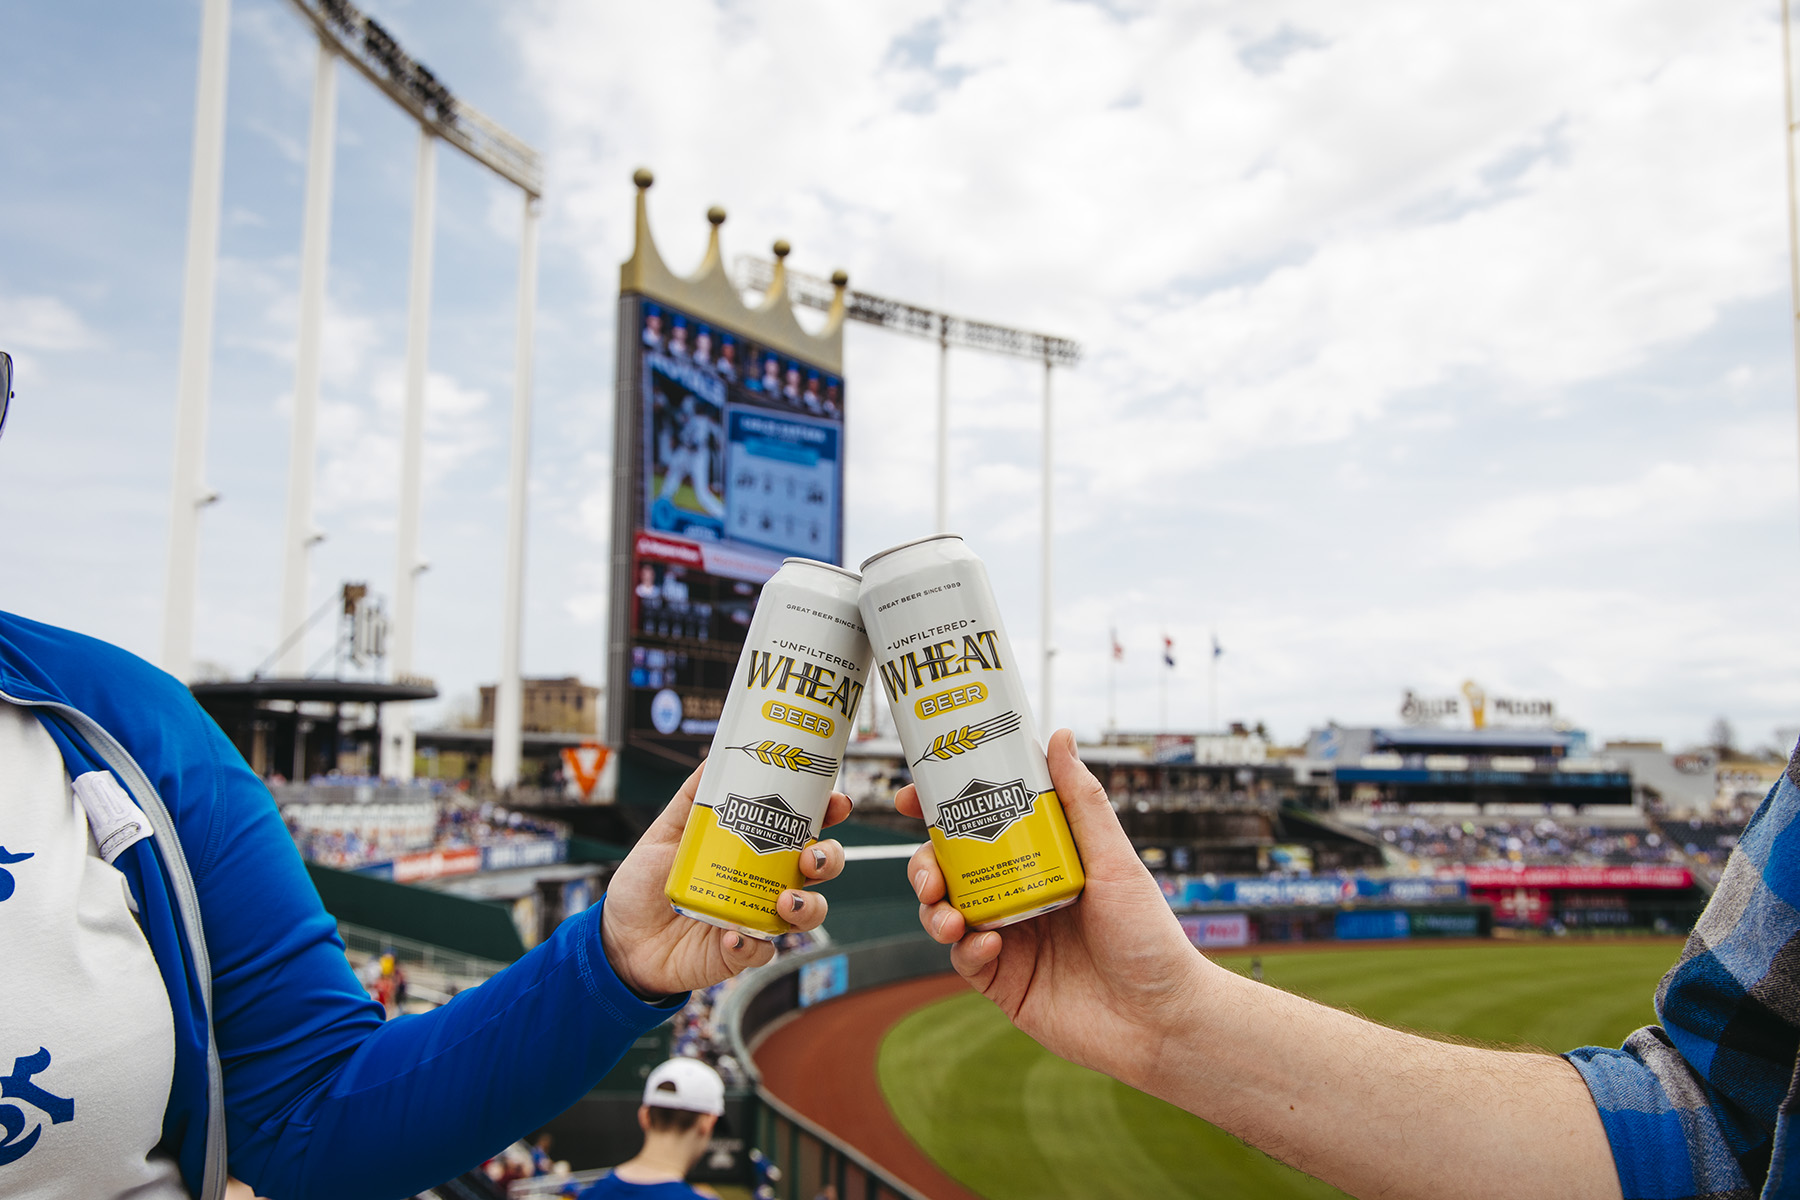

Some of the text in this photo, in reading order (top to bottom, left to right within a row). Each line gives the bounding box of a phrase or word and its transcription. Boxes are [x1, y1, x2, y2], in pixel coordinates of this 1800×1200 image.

[878, 581, 961, 613] GREAT BEER SINCE 1989
[786, 603, 811, 614] GREAT
[812, 610, 834, 621] BEER
[834, 617, 857, 630] SINCE
[892, 619, 968, 650] UNFILTERED
[779, 640, 855, 671] UNFILTERED
[880, 629, 1004, 704] WHEAT
[747, 650, 865, 723] WHEAT
[920, 685, 984, 717] BEER
[769, 702, 832, 736] BEER
[725, 799, 808, 845] BOULEVARD
[942, 785, 1026, 832] BOULEVARD
[961, 810, 1014, 832] BREWING CO.
[739, 823, 790, 845] BREWING CO.
[710, 862, 748, 878] PROUDLY
[748, 873, 781, 888] BREWED
[961, 851, 1041, 880] PROUDLY BREWED IN
[969, 871, 1001, 885] KANSAS
[1023, 861, 1036, 870] MO
[689, 884, 704, 894] 19.2
[705, 889, 716, 898] FL
[717, 893, 731, 902] OZ
[740, 900, 760, 911] 4.4%
[715, 872, 780, 895] KANSAS CITY, MO
[972, 899, 982, 907] FL
[982, 895, 995, 904] OZ
[1004, 886, 1026, 897] 4.4%
[1026, 874, 1065, 892] ALC/VOL
